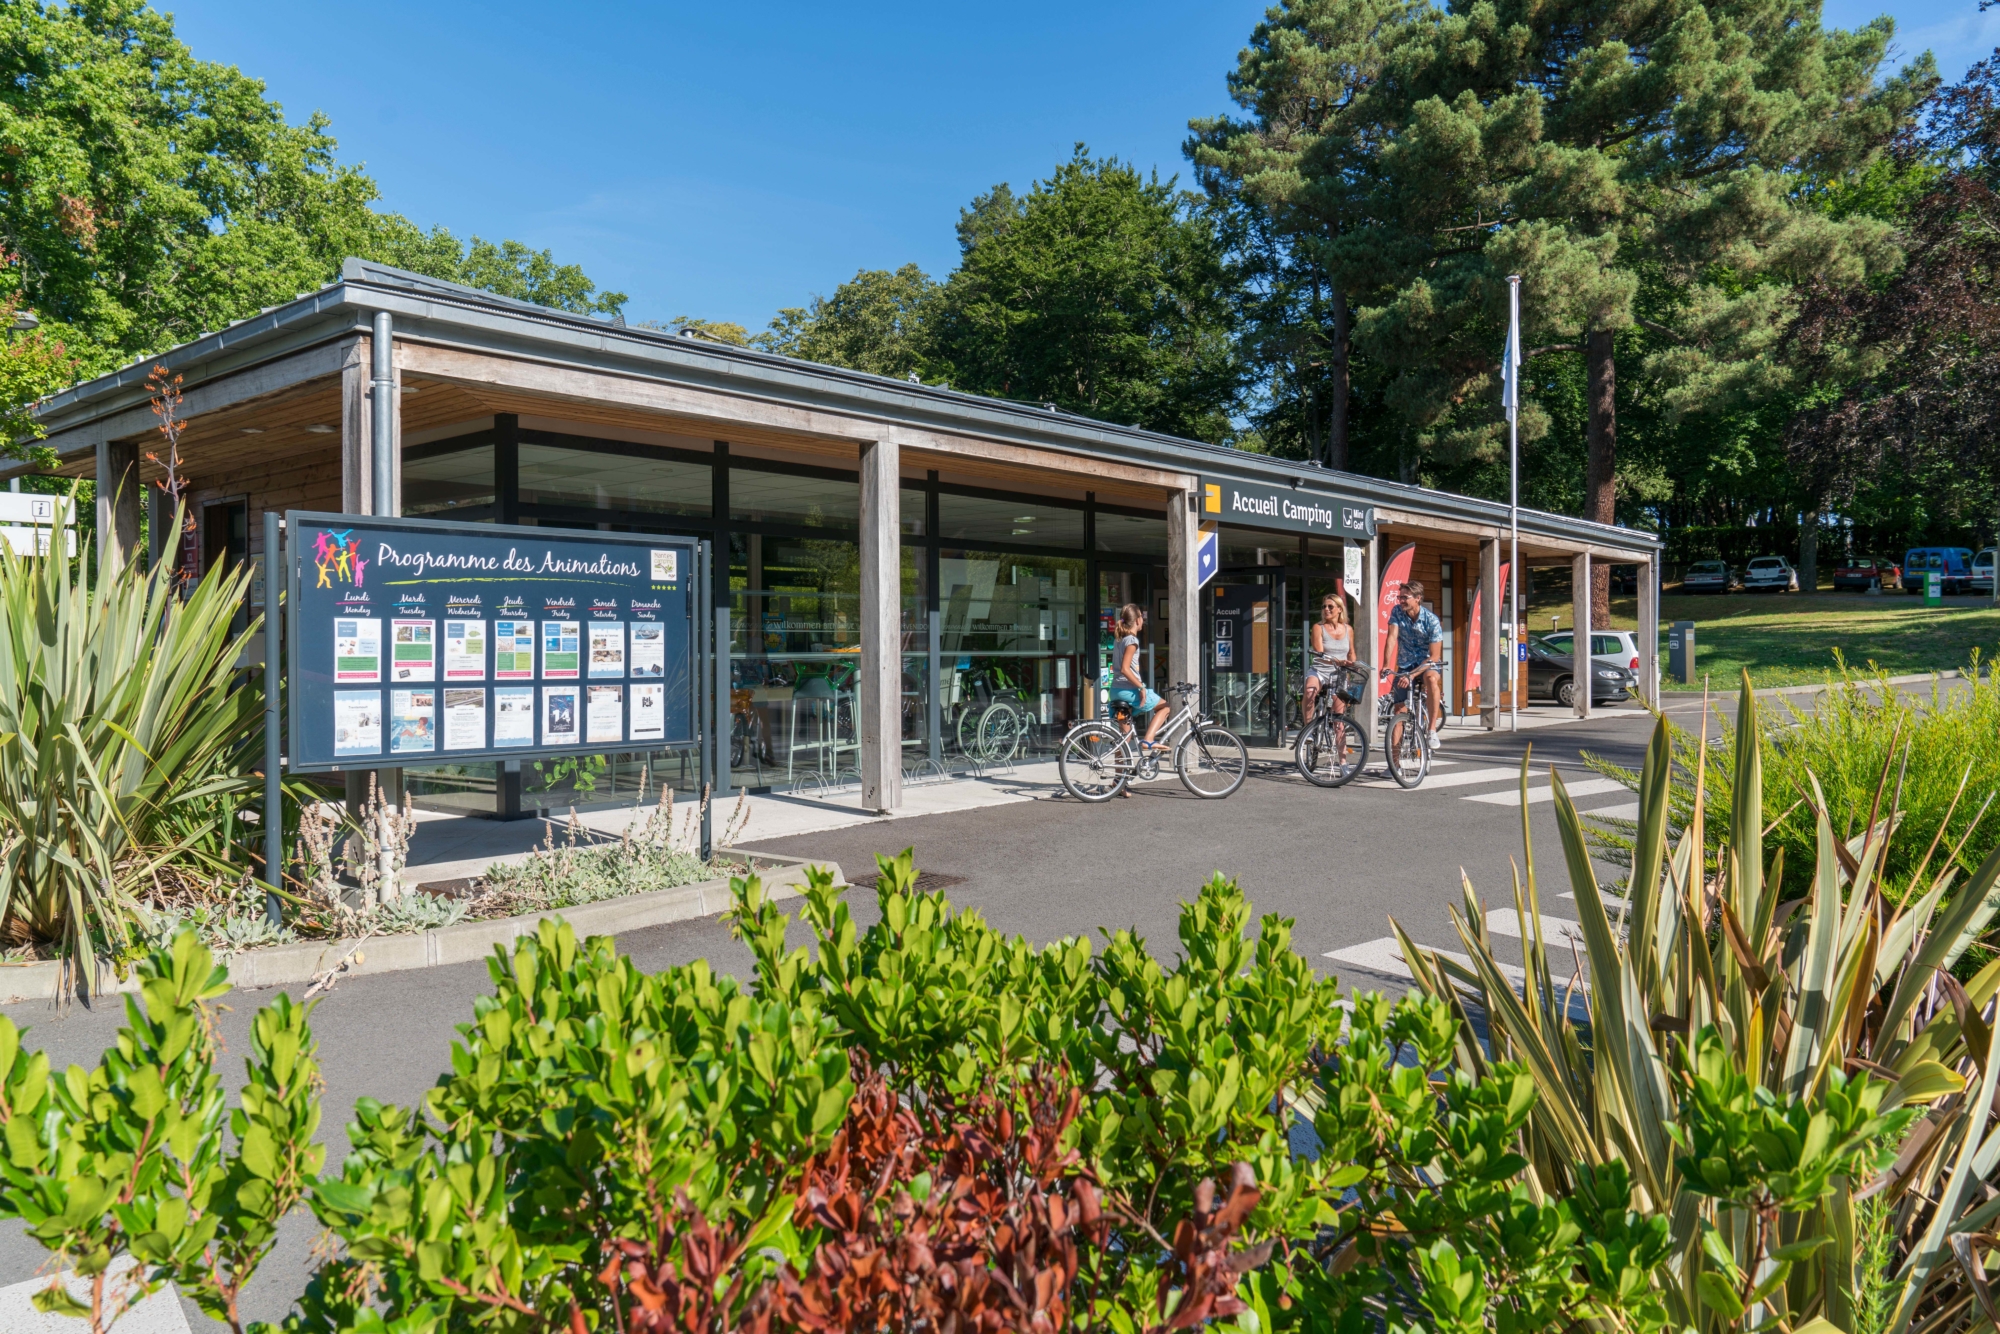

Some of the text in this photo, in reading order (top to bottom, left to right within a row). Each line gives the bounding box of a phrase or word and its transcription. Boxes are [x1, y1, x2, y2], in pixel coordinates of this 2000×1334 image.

[1232, 490, 1332, 529] Accueil Camping
[1353, 509, 1364, 519] Mini
[1353, 520, 1364, 530] Golf
[378, 543, 641, 577] Programme des Animations
[344, 592, 370, 601] Lundi
[399, 593, 426, 602] Mardi
[447, 595, 482, 604] Mercredi
[503, 596, 524, 606] Jeudi
[545, 597, 576, 606] Vendredi
[592, 598, 617, 607] Samedi
[631, 599, 662, 608] Dimanche
[343, 606, 371, 616] Monday
[398, 606, 426, 617] Tuesday
[447, 607, 481, 618] Wednesday
[500, 608, 528, 618] Thursday
[551, 609, 570, 620] Friday
[593, 610, 617, 620] Saturday
[637, 611, 656, 621] Sunday
